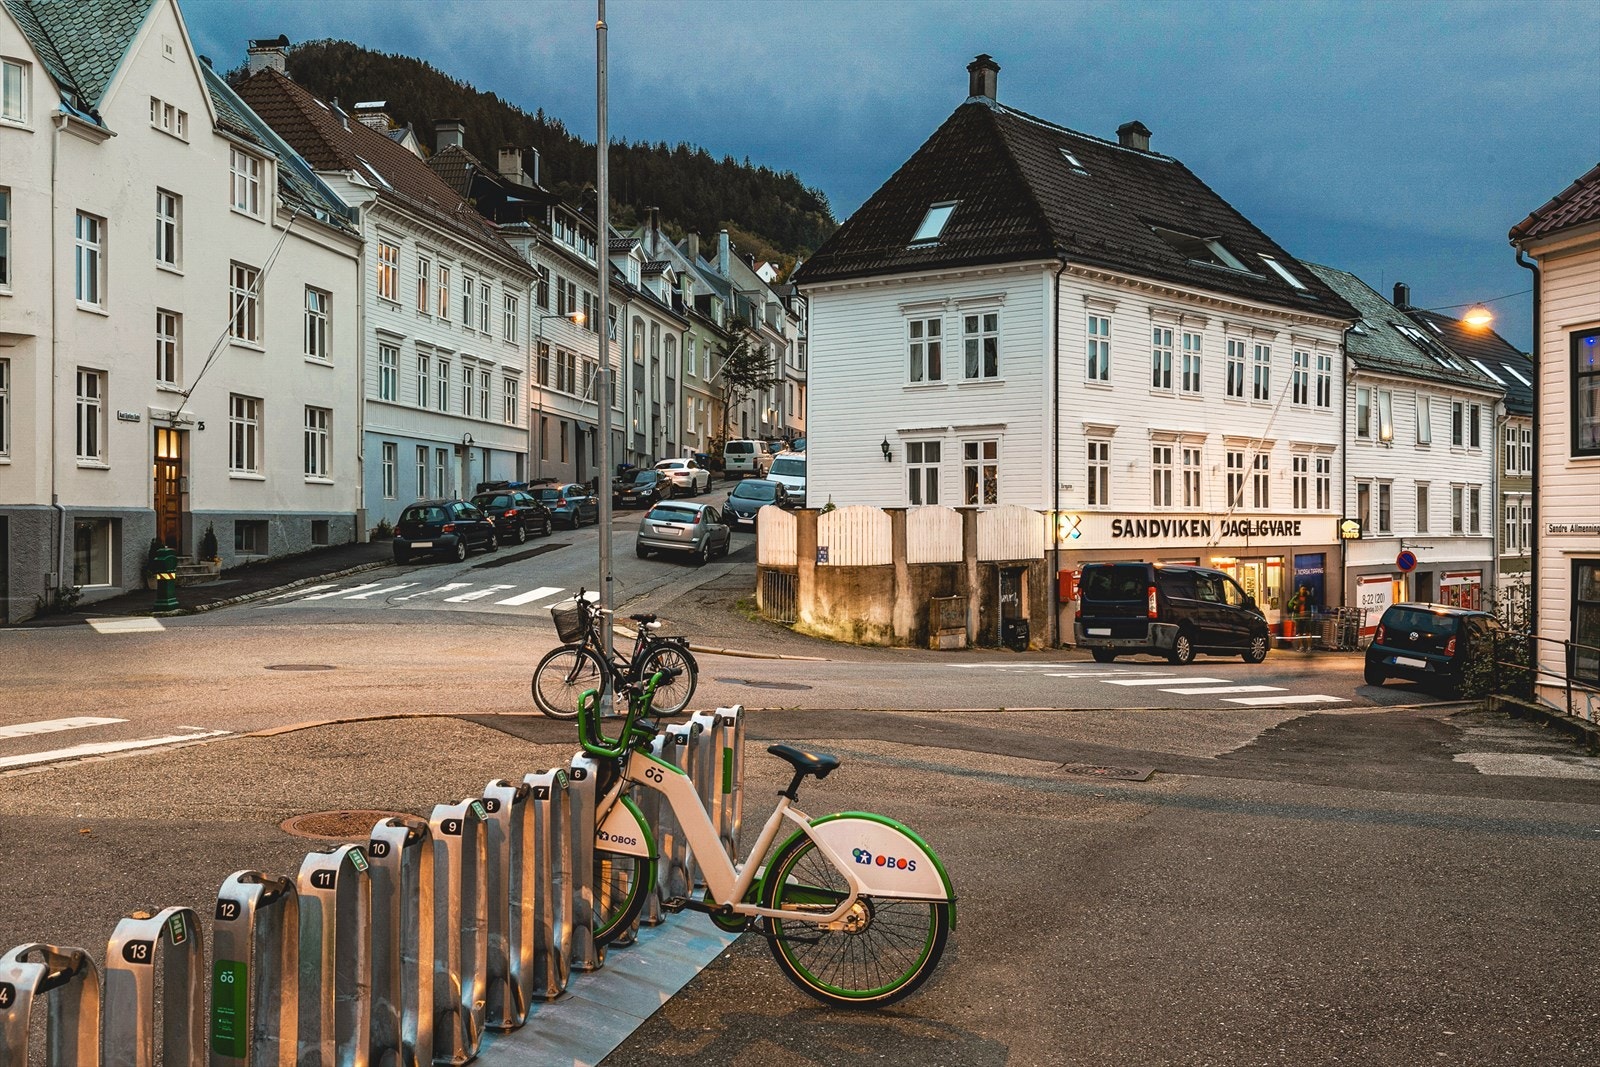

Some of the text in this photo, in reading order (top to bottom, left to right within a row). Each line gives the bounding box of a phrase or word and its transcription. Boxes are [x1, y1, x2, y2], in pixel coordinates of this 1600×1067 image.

[1111, 518, 1301, 538] SANDVIKEN DAGLIGVARE
[1361, 593, 1374, 605] 8-22
[677, 735, 684, 744] 3
[617, 756, 624, 766] 5
[574, 769, 582, 779] 6
[537, 788, 545, 798] 7
[486, 800, 494, 811] 8
[448, 821, 457, 832] 9
[610, 834, 637, 846] OBOS
[372, 843, 385, 855] 10
[875, 854, 917, 872] OBOS
[318, 873, 331, 886] 11
[221, 903, 235, 917] 12
[130, 944, 147, 959] 13
